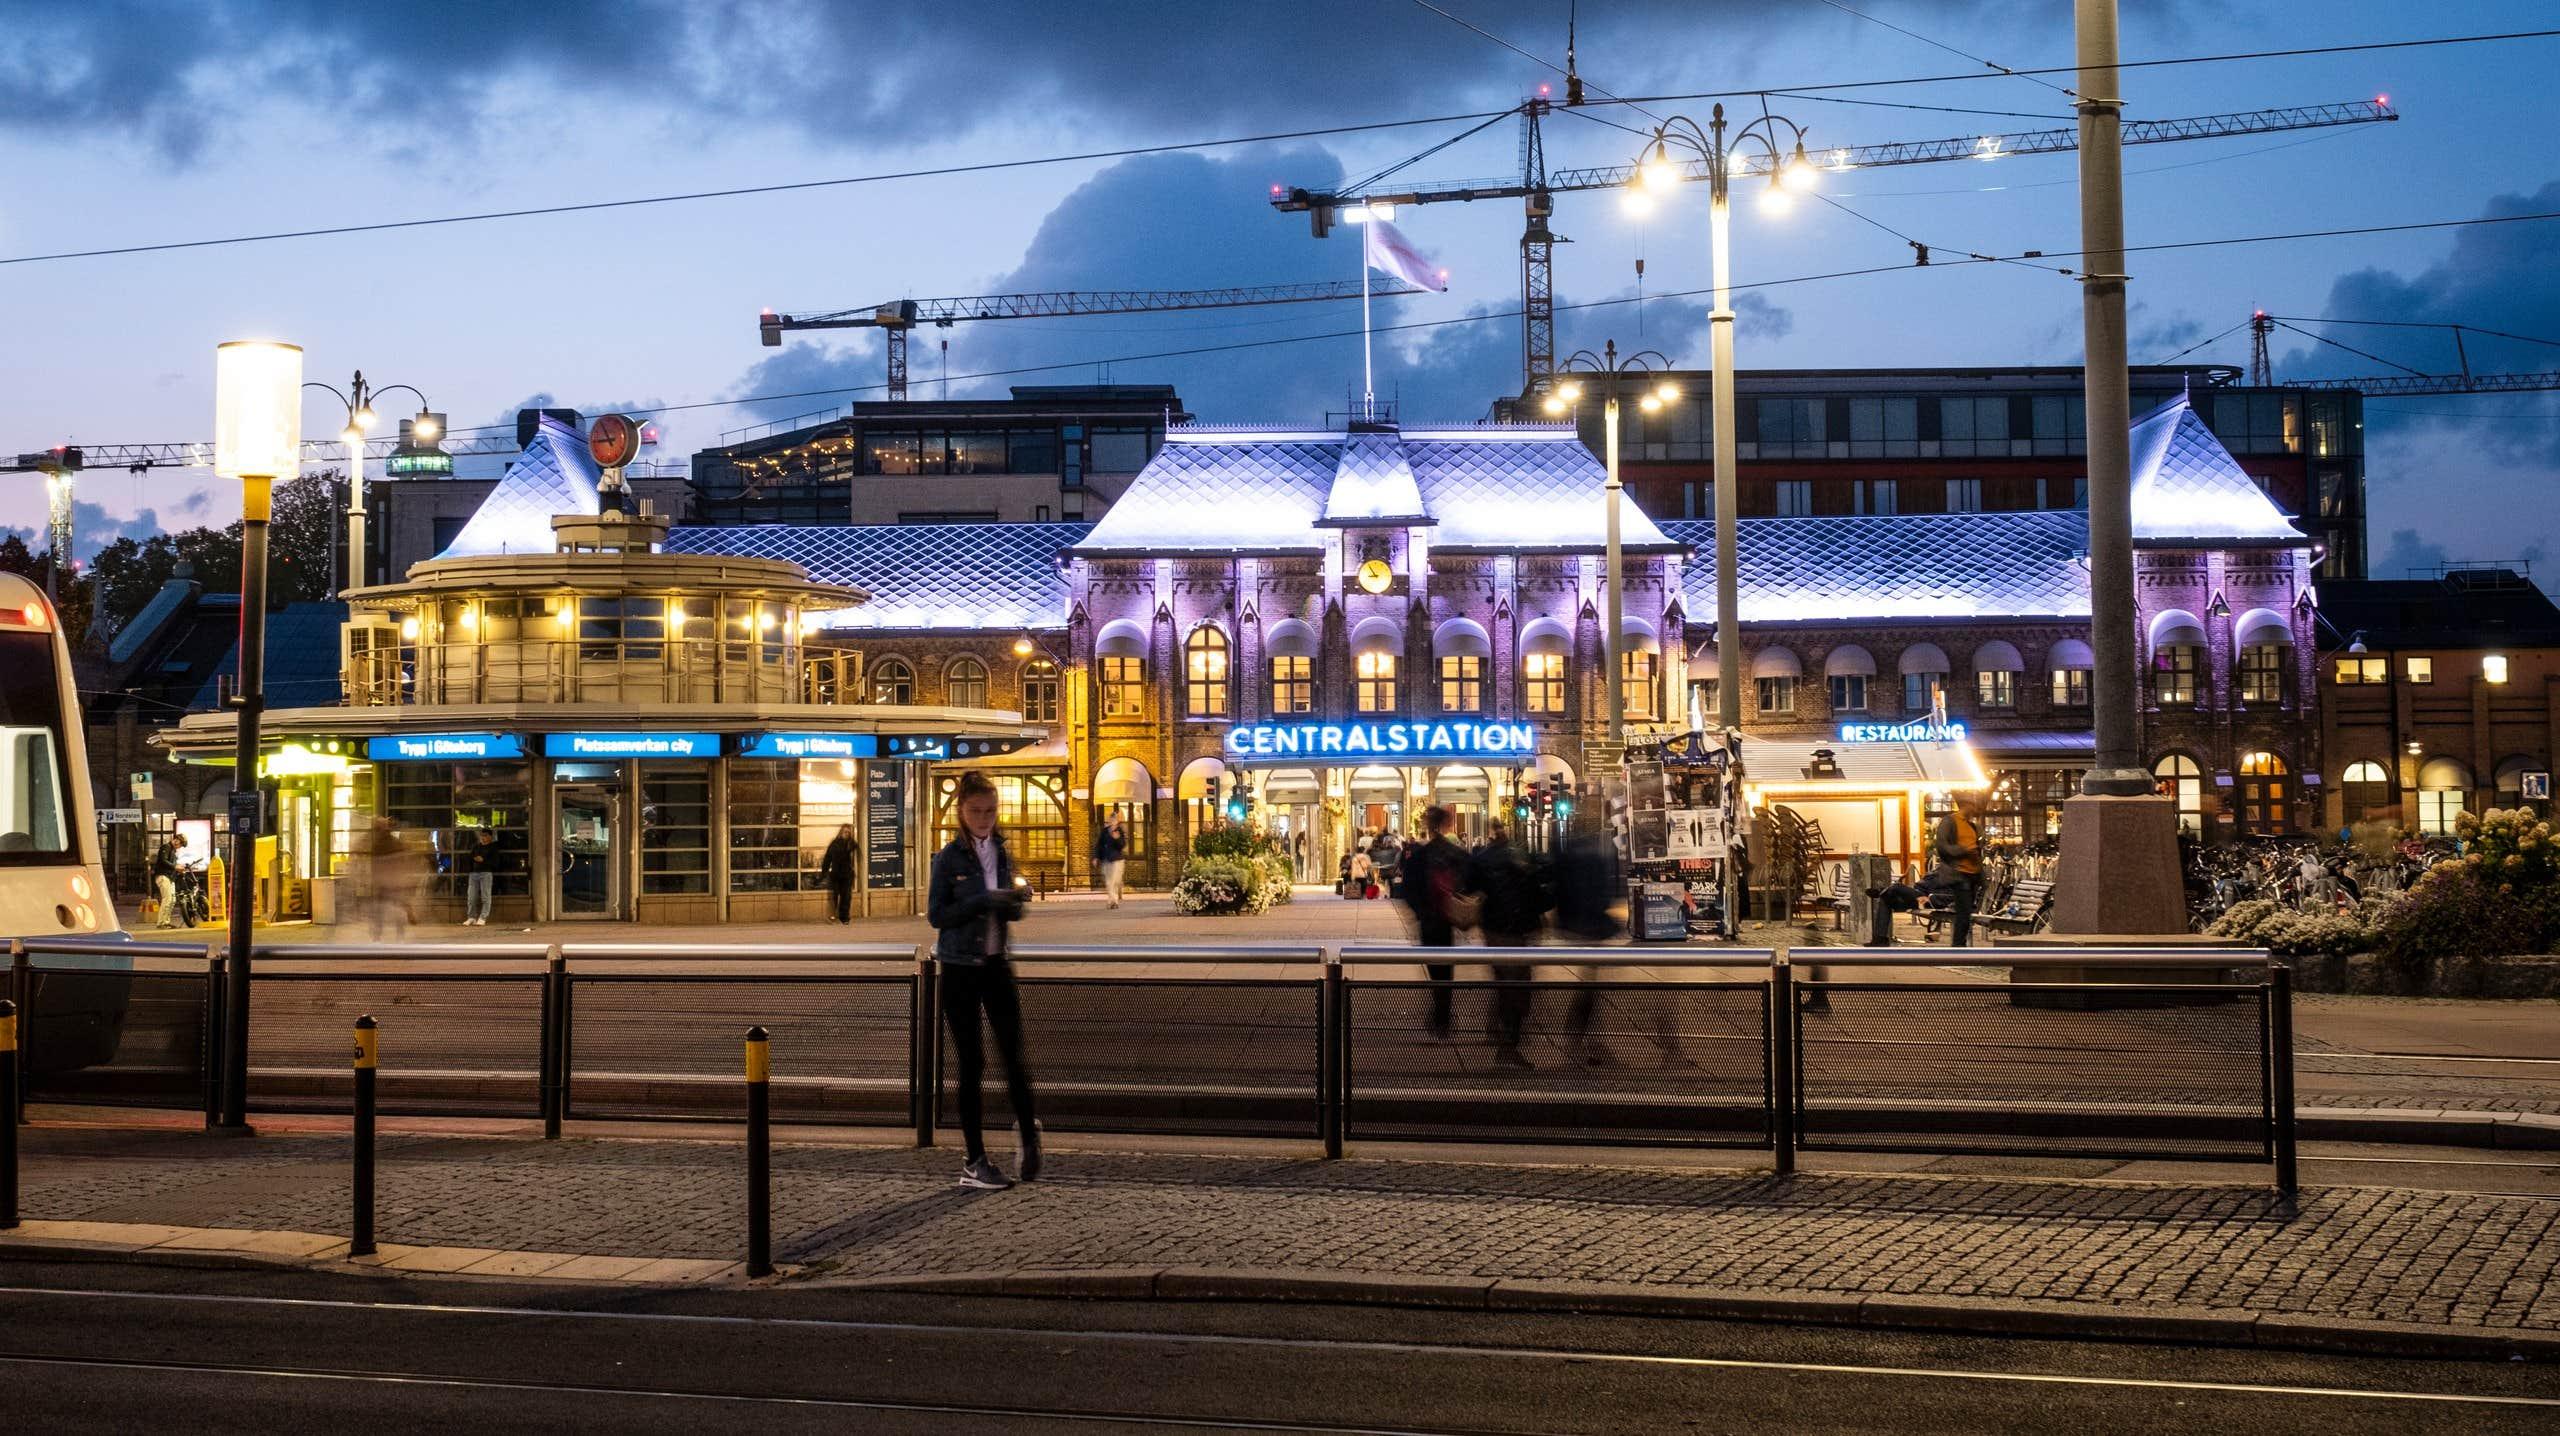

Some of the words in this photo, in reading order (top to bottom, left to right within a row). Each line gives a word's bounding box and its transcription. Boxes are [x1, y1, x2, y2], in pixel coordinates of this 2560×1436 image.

[1229, 725, 1533, 753] CENTRALSTATION
[1842, 725, 1965, 741] RESTAURANG
[398, 740, 427, 757] Trygg
[428, 740, 433, 753] i
[434, 739, 486, 756] Göteborg
[670, 738, 694, 754] city
[776, 738, 804, 755] Trygg
[805, 738, 809, 751] i
[810, 739, 853, 755] Göteborg
